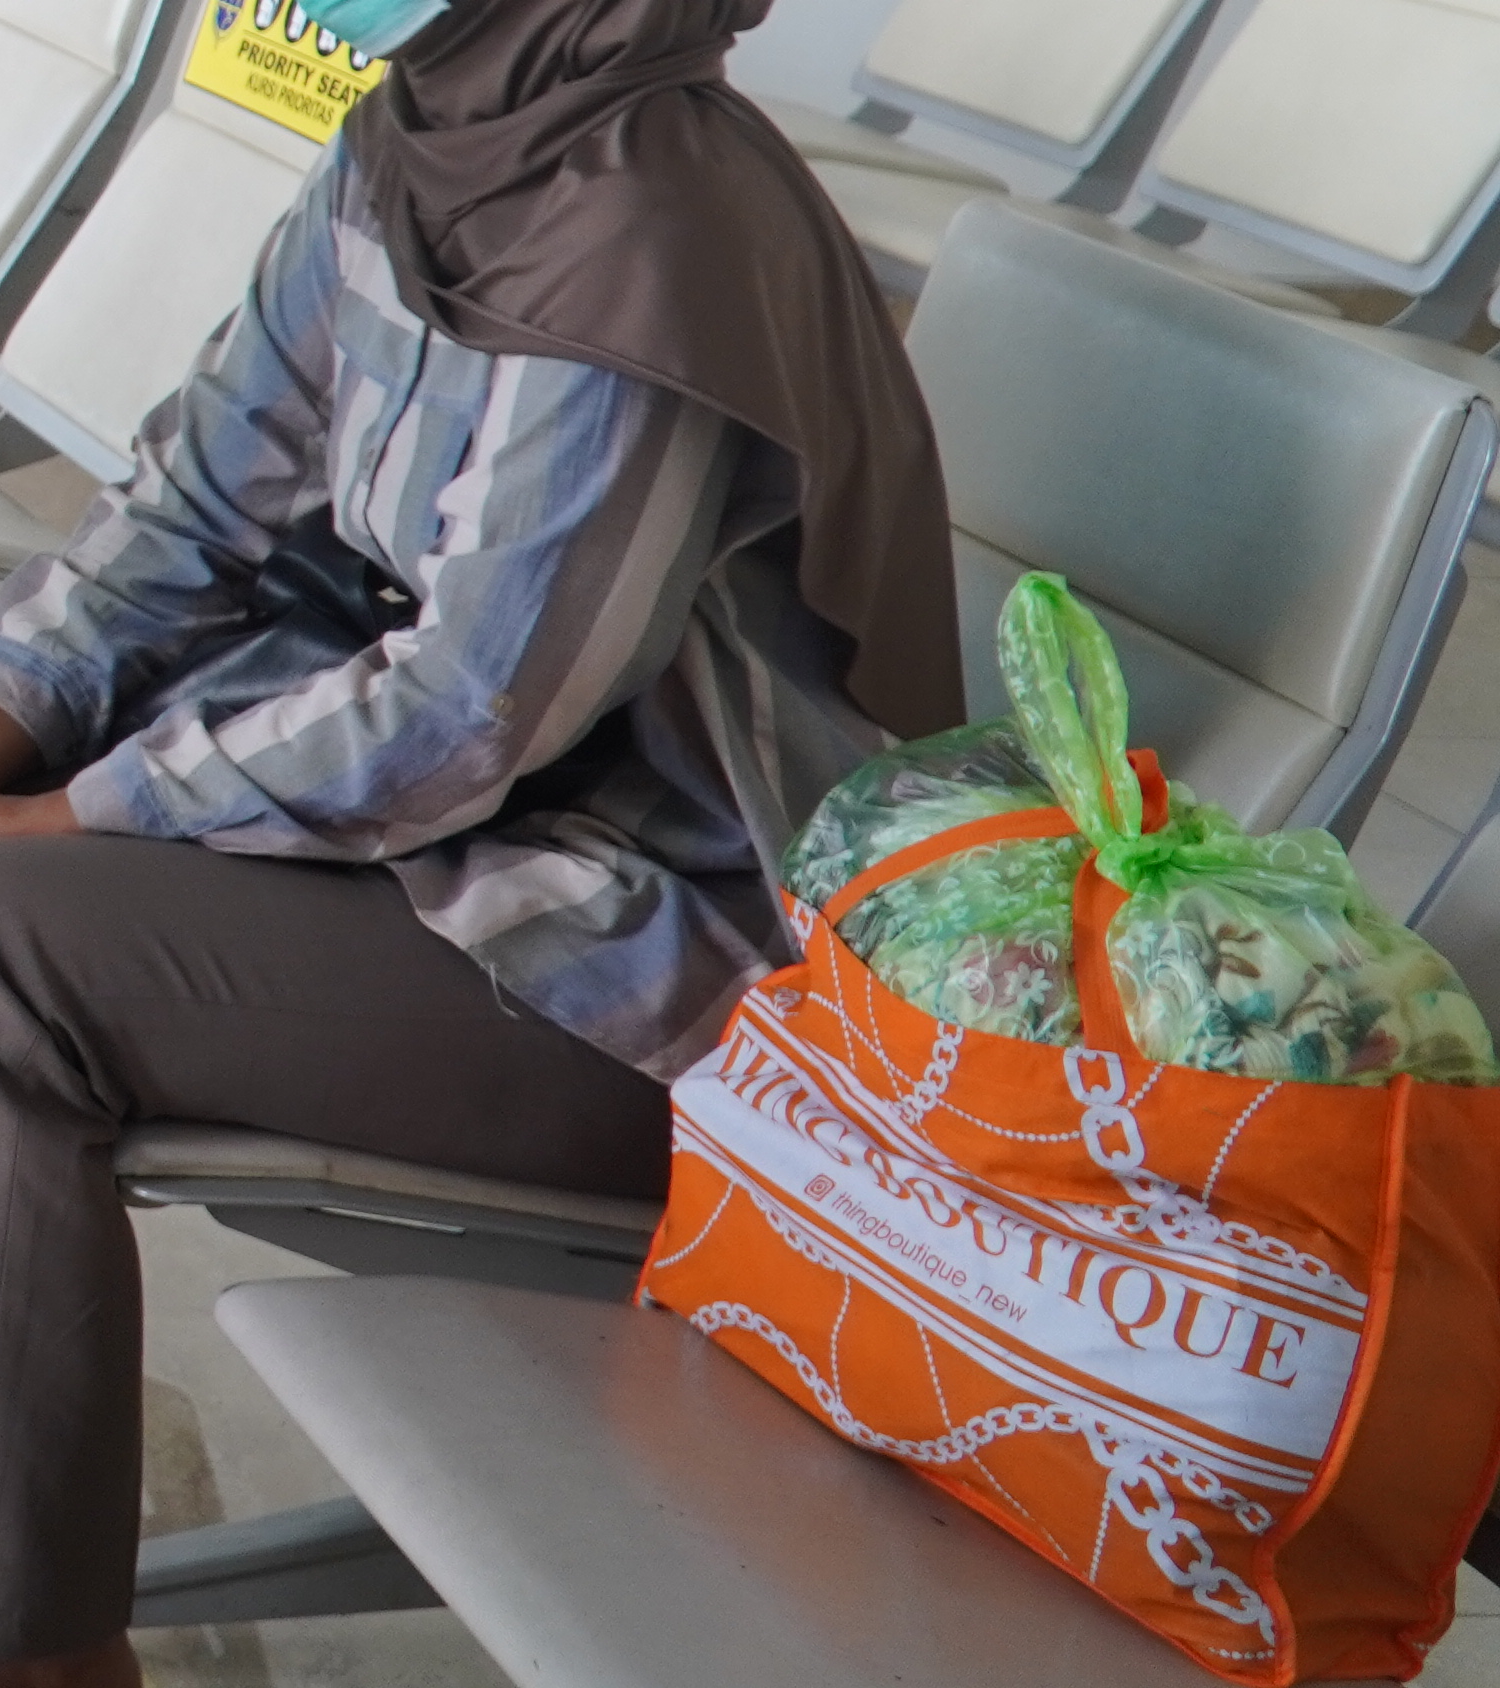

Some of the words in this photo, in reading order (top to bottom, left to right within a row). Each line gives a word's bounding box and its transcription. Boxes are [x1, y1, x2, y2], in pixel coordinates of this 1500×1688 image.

[238, 40, 315, 86] PRIORITY
[317, 74, 363, 105] SEAT
[278, 82, 335, 125] PRIORITAS
[831, 1191, 1028, 1324] thingboutique_new
